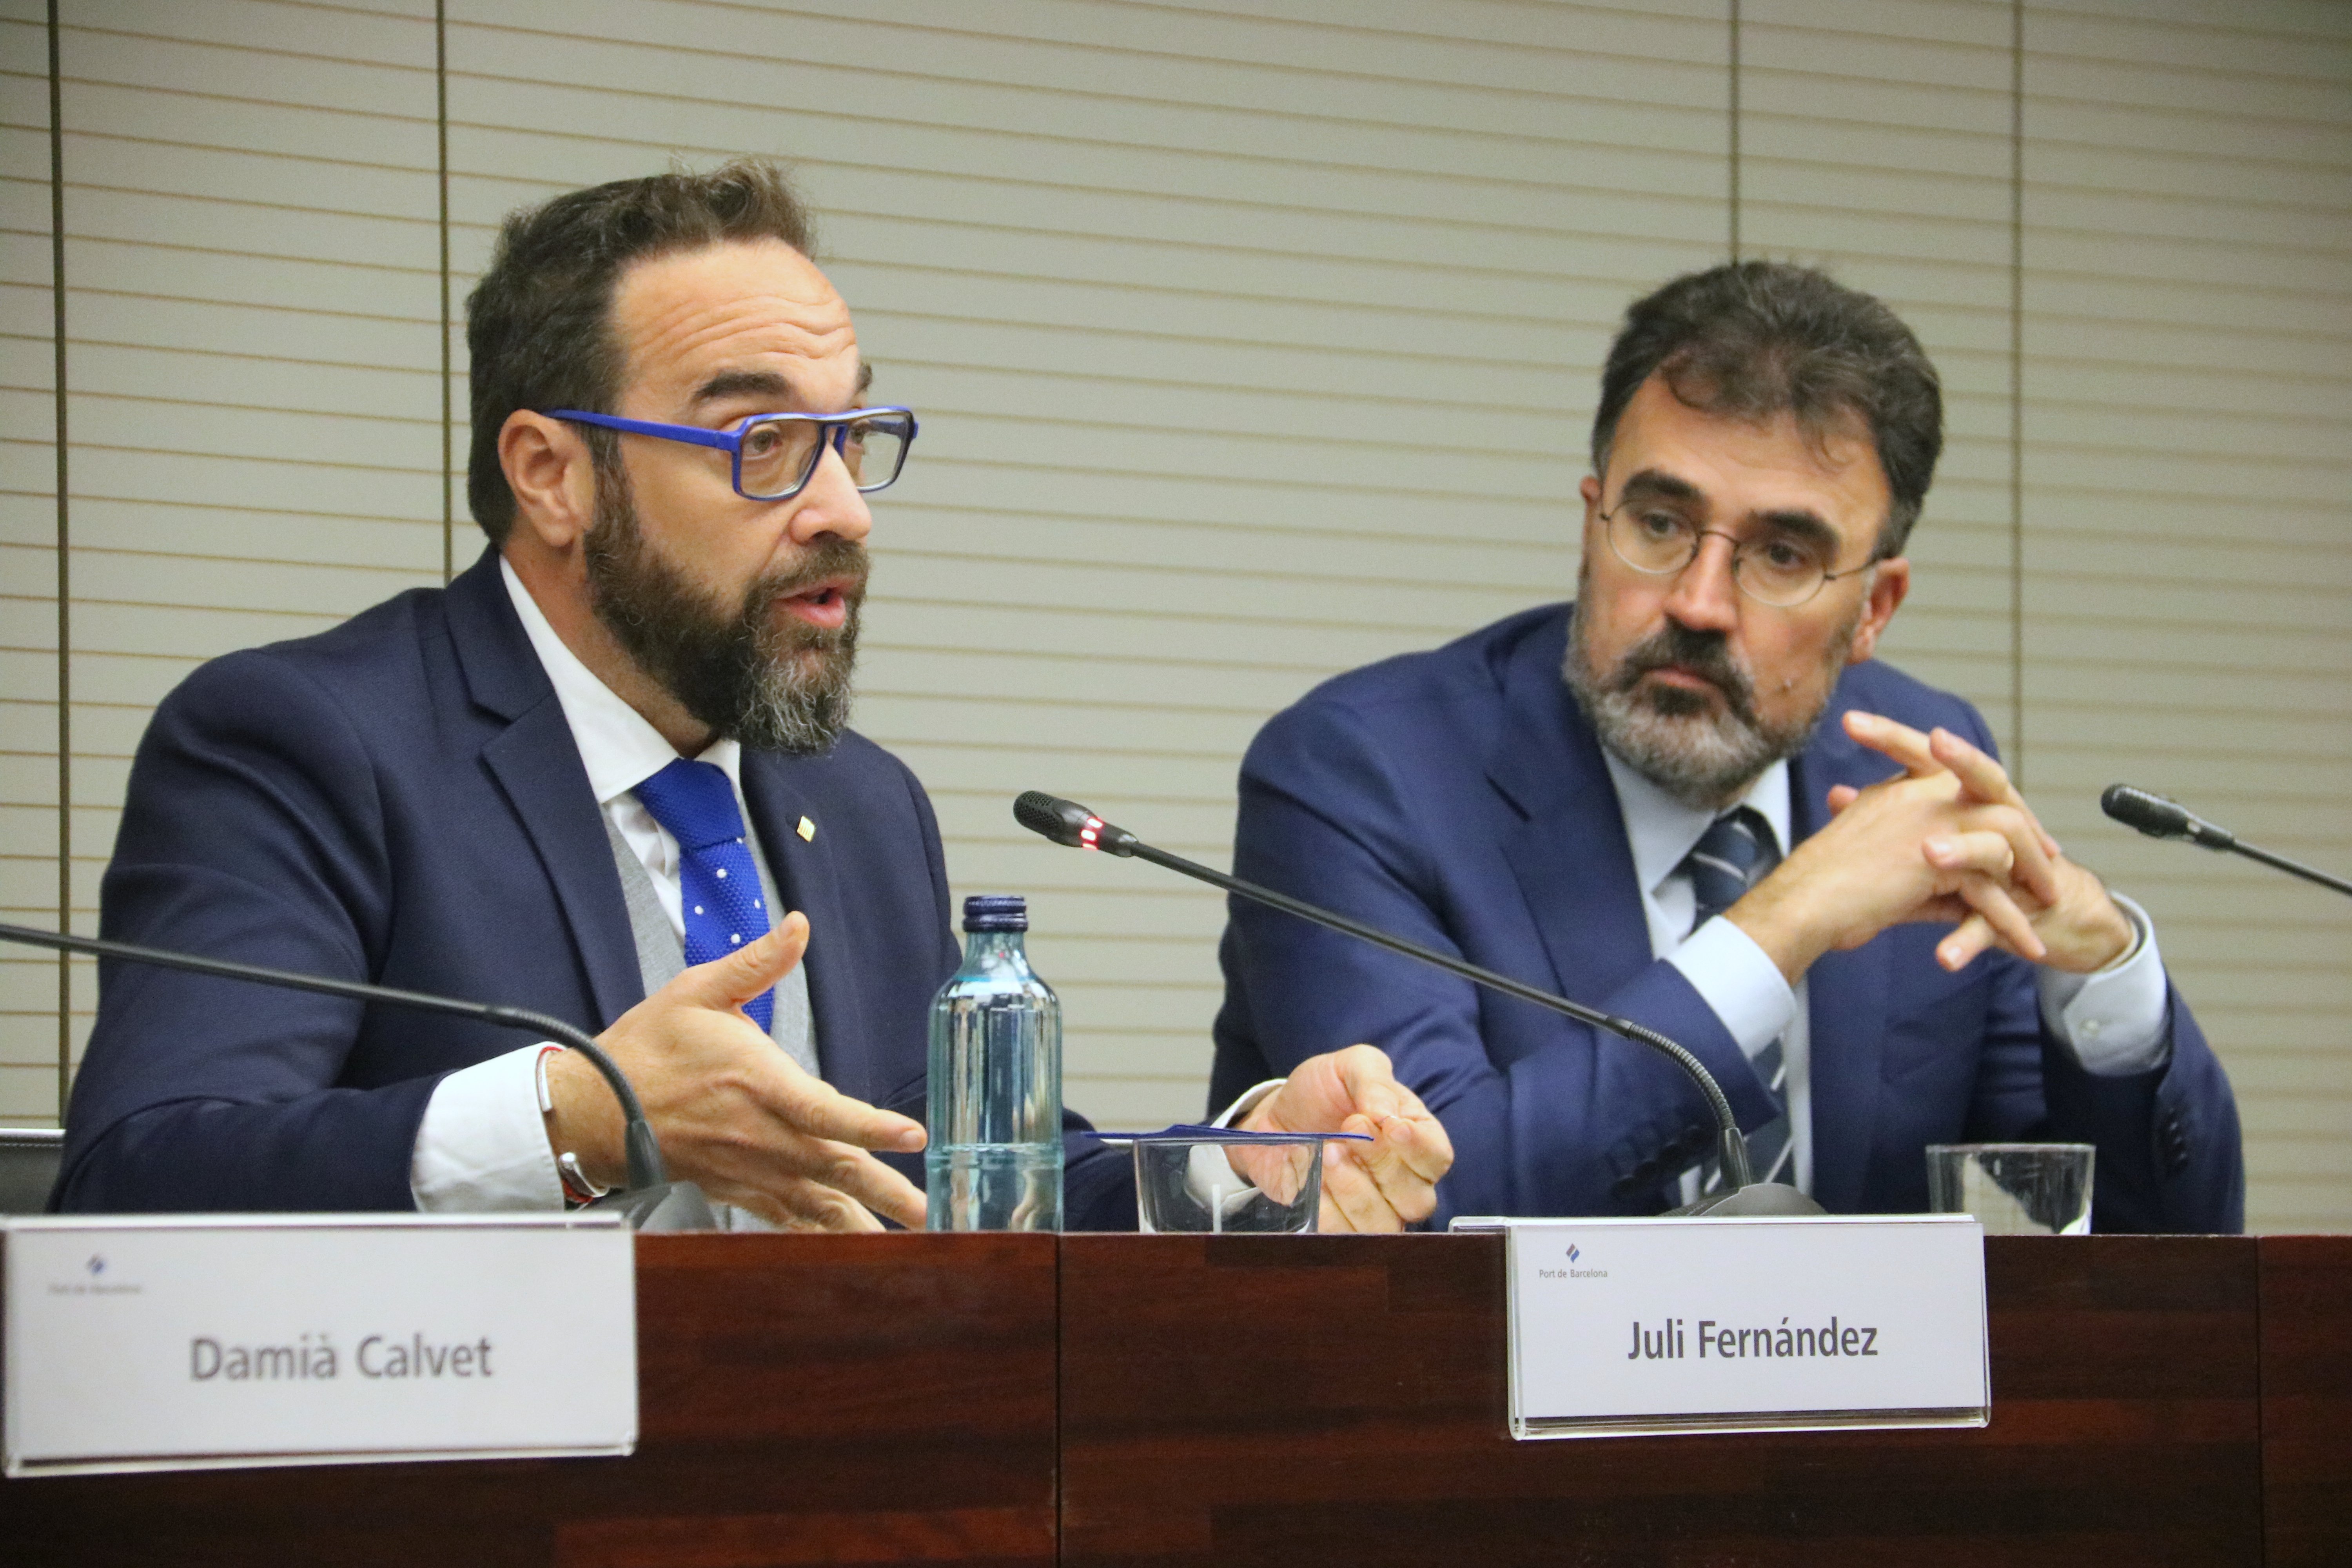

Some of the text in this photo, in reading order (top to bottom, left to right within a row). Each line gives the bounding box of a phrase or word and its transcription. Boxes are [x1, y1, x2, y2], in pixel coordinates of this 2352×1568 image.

[1539, 1269, 1608, 1278] Port de Barcelona
[191, 1334, 492, 1380] Damià Calvet
[1628, 1316, 1878, 1359] Juli Fernández
